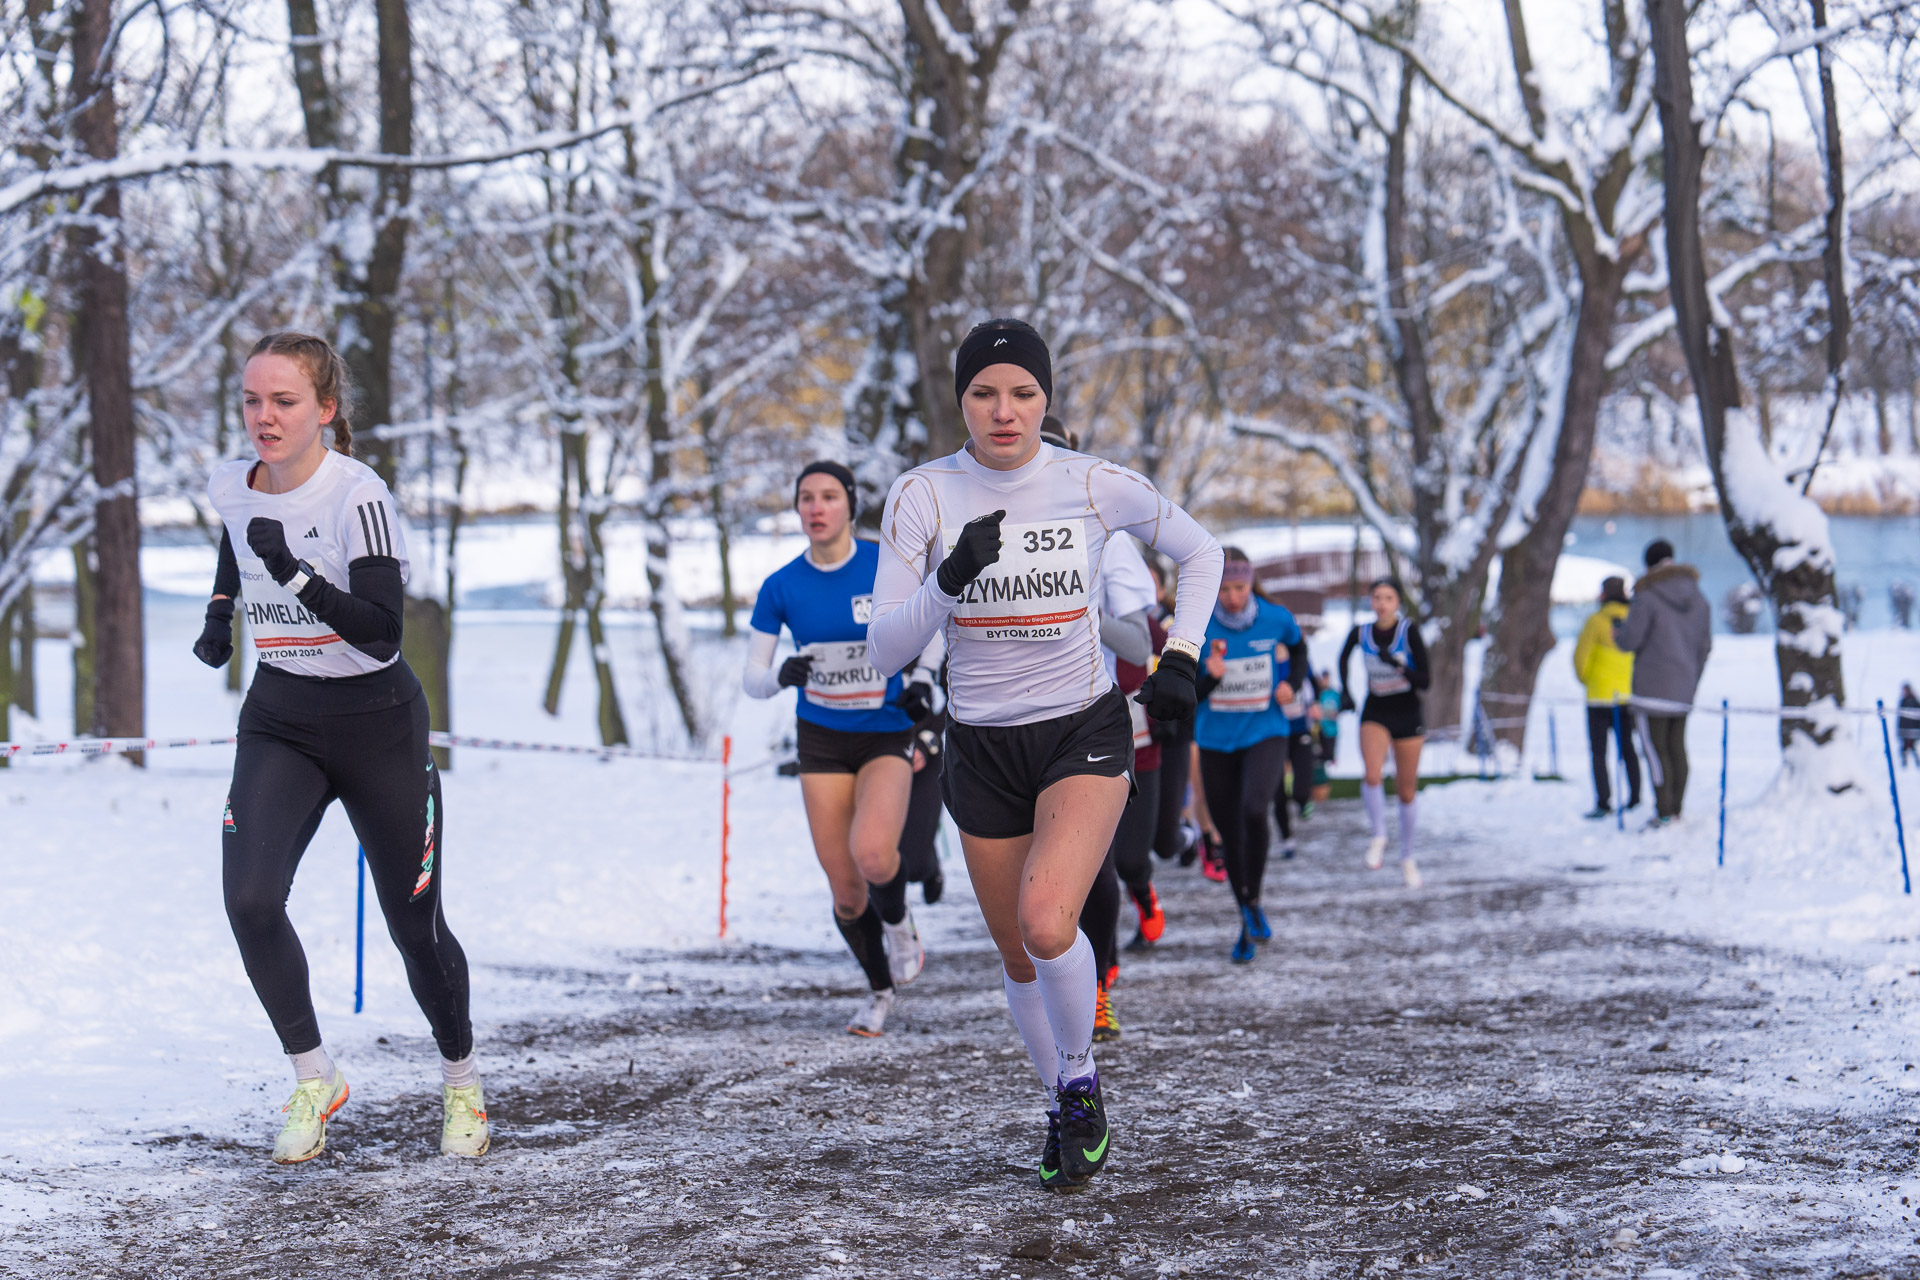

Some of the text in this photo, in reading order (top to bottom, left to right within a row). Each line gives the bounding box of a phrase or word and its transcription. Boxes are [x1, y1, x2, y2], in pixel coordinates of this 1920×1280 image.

[1023, 528, 1074, 553] 352
[244, 602, 317, 625] HMIELA
[986, 627, 1062, 639] BYTOM 2024
[260, 648, 324, 660] BYTOM 2024
